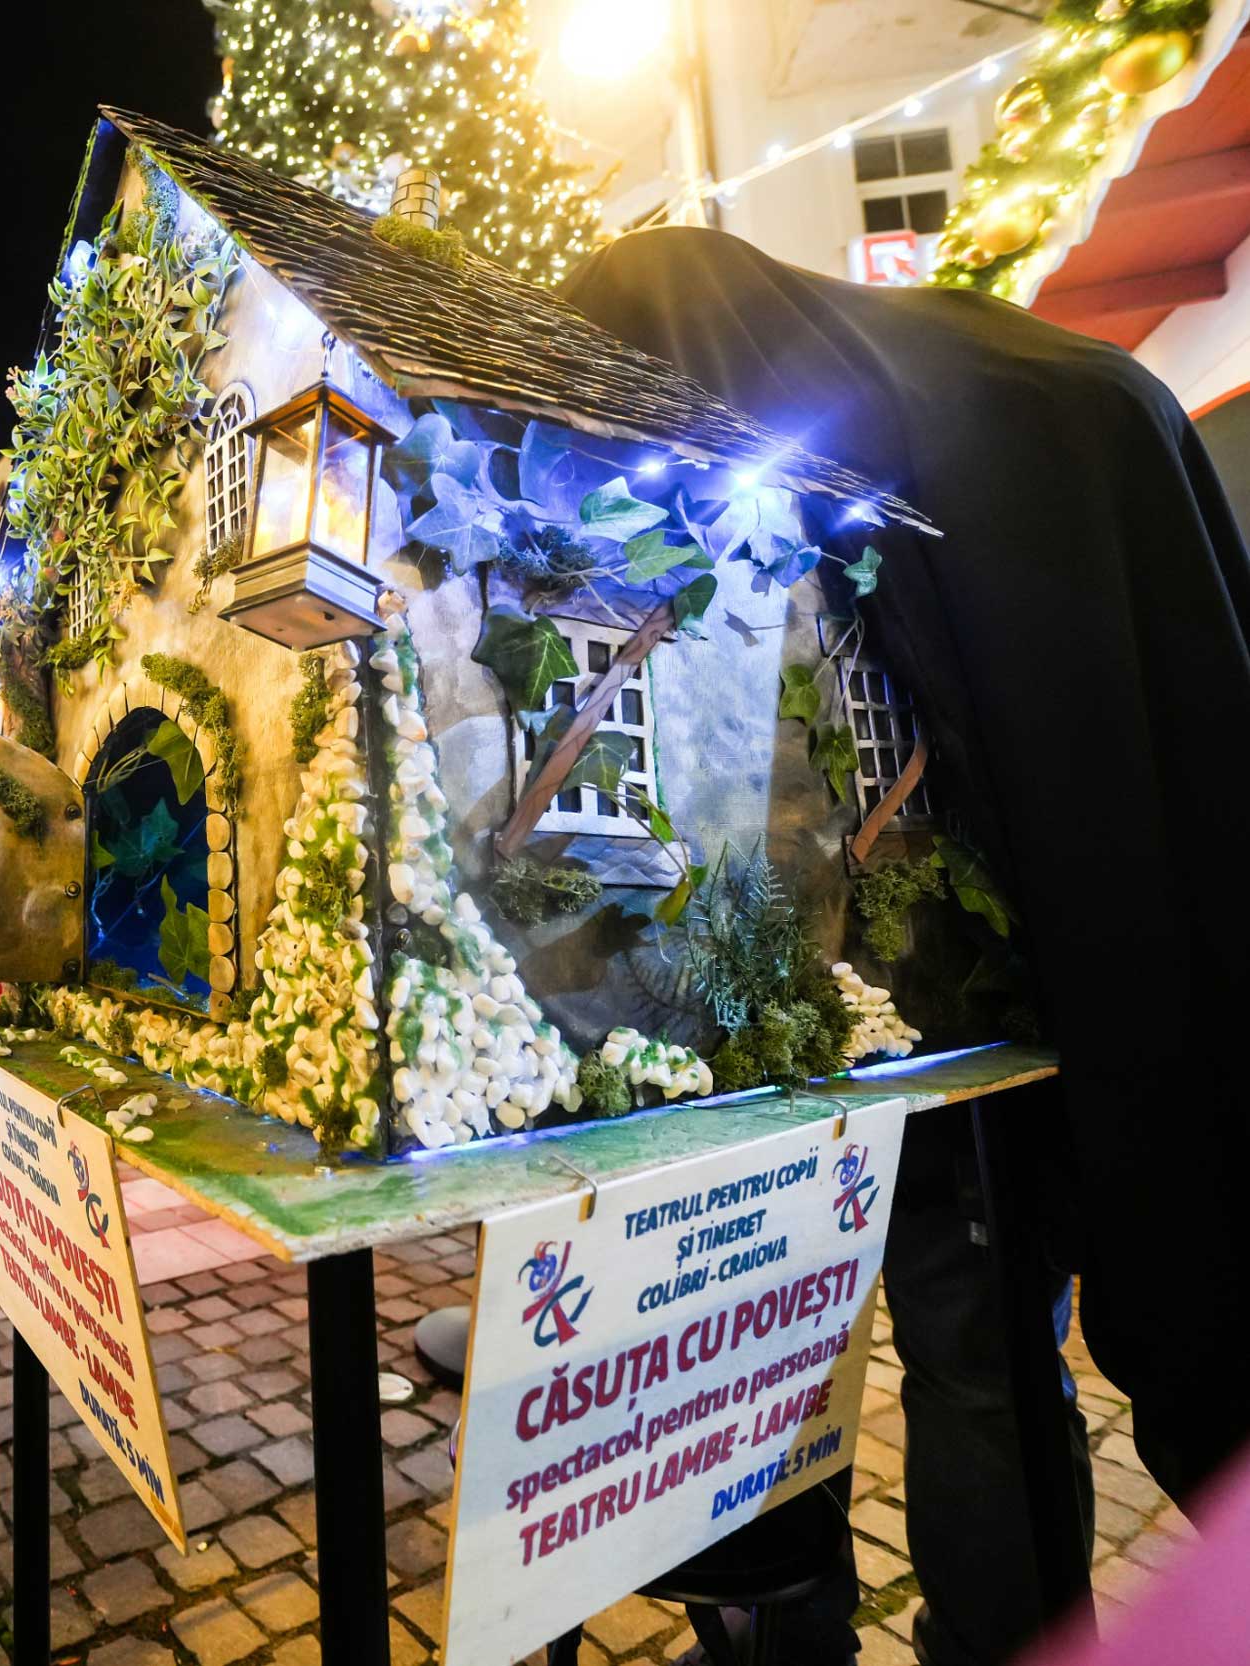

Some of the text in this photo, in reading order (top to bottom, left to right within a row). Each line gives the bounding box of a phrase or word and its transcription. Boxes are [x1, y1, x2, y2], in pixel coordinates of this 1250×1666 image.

[25, 1197, 48, 1247] CU
[625, 1192, 704, 1240] TEATRUL
[706, 1169, 776, 1213] PENTRU
[0, 1243, 40, 1310] TEATRU
[38, 1288, 81, 1361] LAMBE
[85, 1343, 139, 1431] LAMBE
[28, 1247, 64, 1304] pentru
[62, 1286, 72, 1311] o
[71, 1294, 136, 1383] persoană
[515, 1257, 860, 1442] CĂSUȚA CU POVEȘTI
[126, 1437, 137, 1468] 5
[505, 1320, 851, 1515] spectacol pentru o persoană
[519, 1469, 643, 1567] TEATRU
[643, 1422, 740, 1504] LAMBE
[750, 1377, 834, 1449] LAMBE
[791, 1445, 804, 1476] 5
